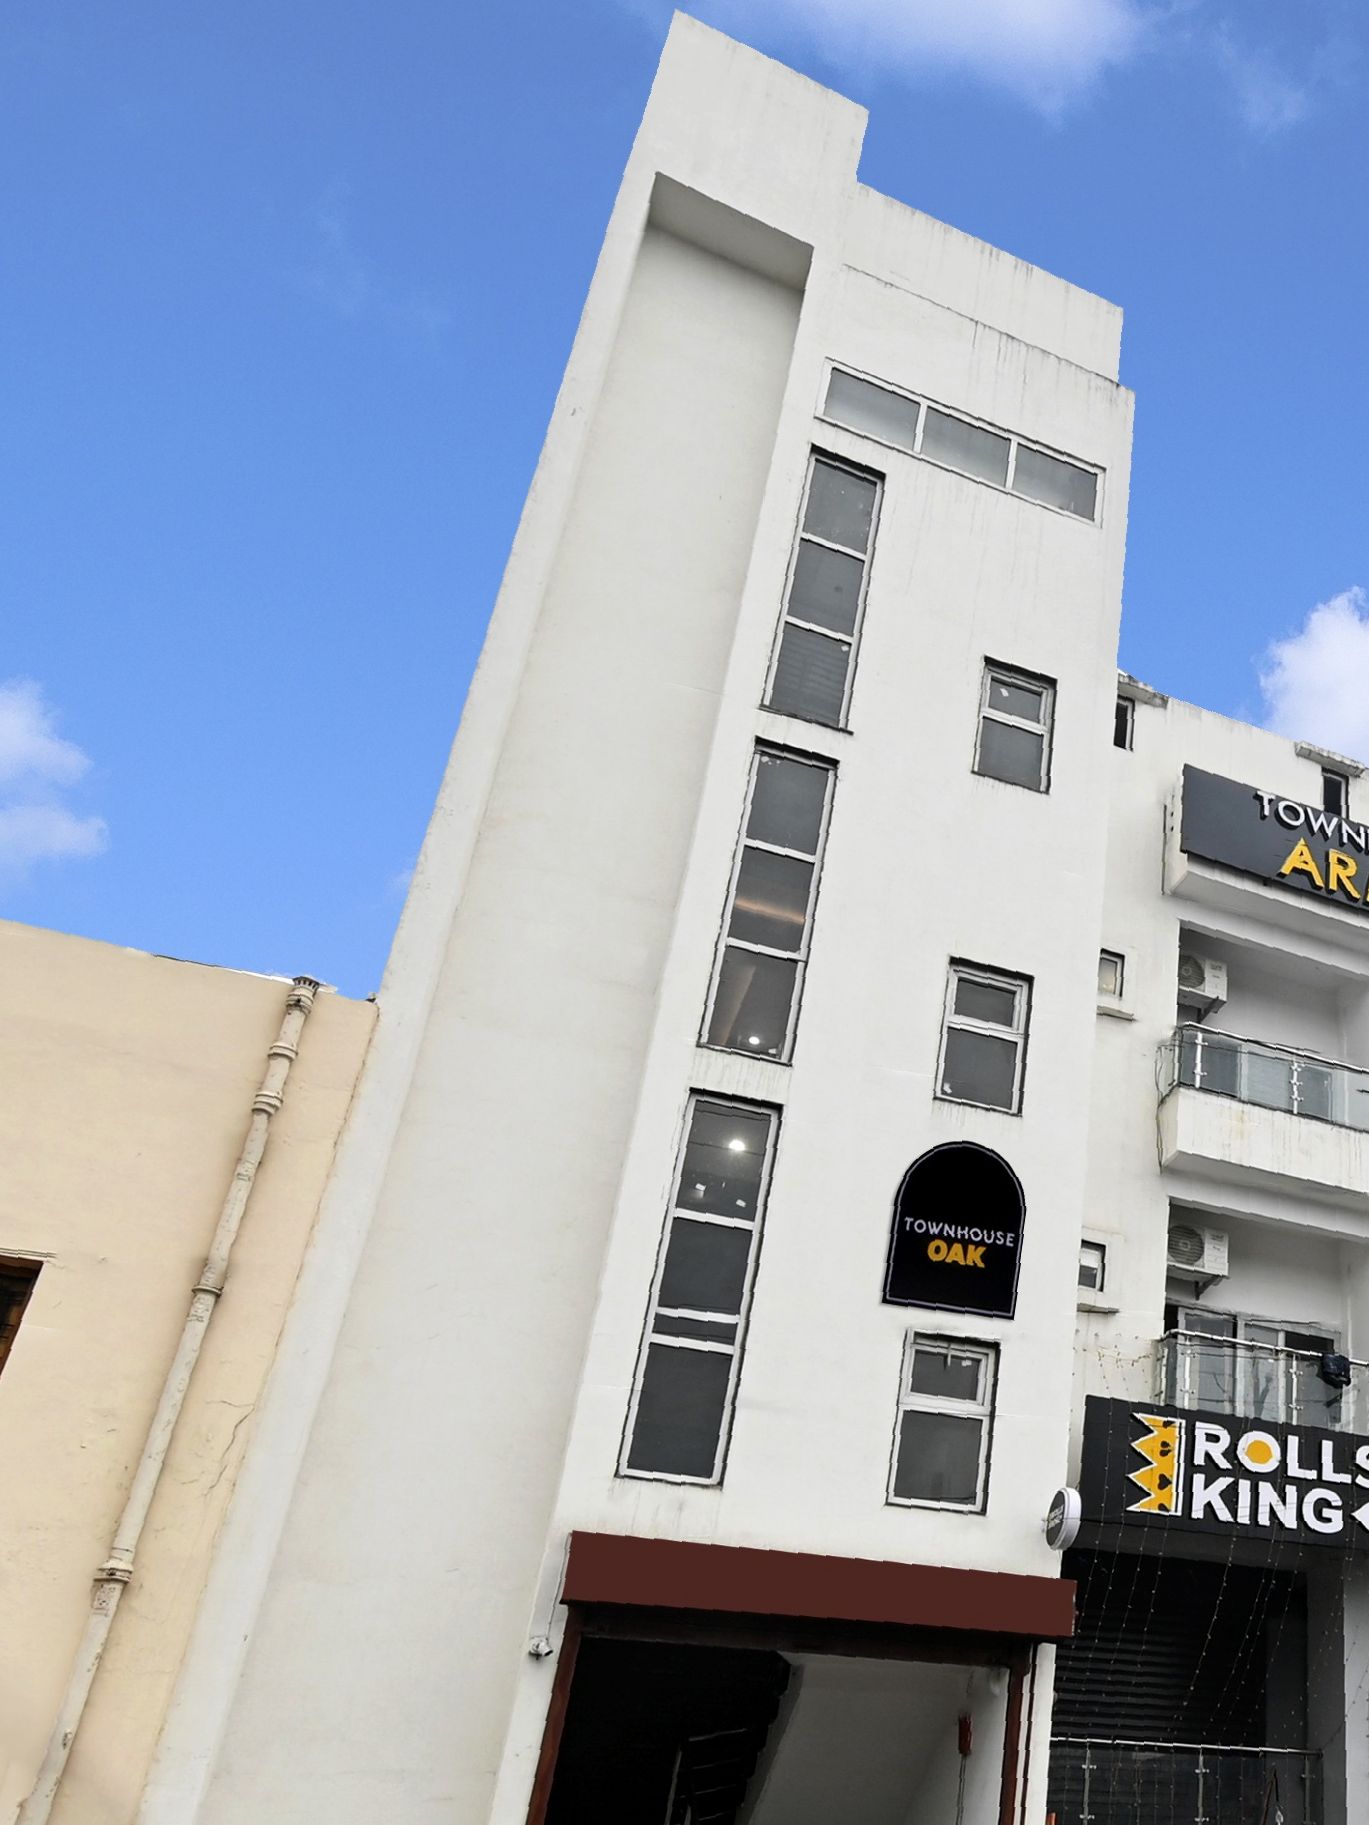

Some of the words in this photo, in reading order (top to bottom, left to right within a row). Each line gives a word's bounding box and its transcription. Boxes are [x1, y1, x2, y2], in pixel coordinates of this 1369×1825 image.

[904, 1216, 1016, 1247] TOWNHOUSE
[927, 1239, 987, 1268] OAK
[1190, 1472, 1345, 1534] KING
